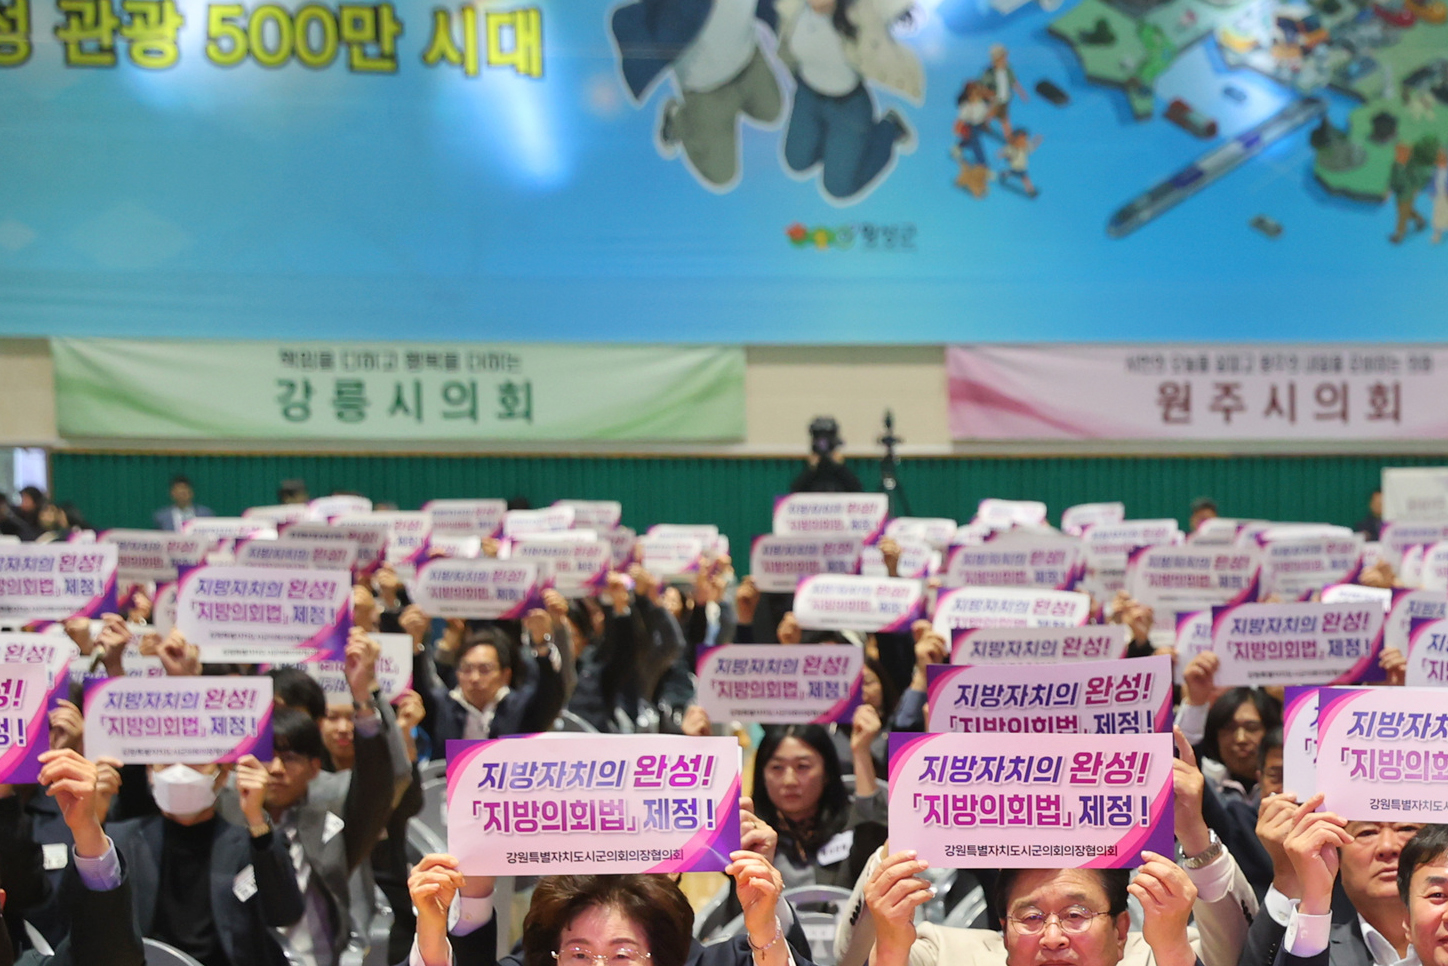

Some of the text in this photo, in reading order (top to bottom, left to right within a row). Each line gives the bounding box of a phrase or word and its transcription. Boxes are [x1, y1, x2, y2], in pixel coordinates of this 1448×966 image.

[54, 0, 184, 70] 관광
[205, 3, 400, 73] 500만
[424, 5, 545, 78] 시대
[275, 377, 534, 424] 강릉시의회
[1156, 381, 1400, 425] 원주시의회
[195, 577, 338, 600] 지방자치의 완성!
[1231, 611, 1370, 636] 지방자치의 완성!
[4, 643, 56, 664] 완성!
[970, 635, 1112, 659] 지방자치의 완성!
[714, 655, 850, 675] 지방자치의 완성!
[104, 688, 258, 711] 지방자치의 완성!
[954, 672, 1152, 708] 지방자치의 완성!
[100, 715, 207, 738] 「지방의회법」
[478, 753, 715, 790] 지방자치의 완성!
[919, 751, 1151, 785] 지방자치의 완성!
[472, 798, 637, 833] 「지방의회법」
[912, 792, 1073, 828] 「지방의회법」
[506, 849, 685, 864] 강원특별자치도시군의회의장협의회
[944, 844, 1118, 858] 강원특별자치도시군의회의장협의회
